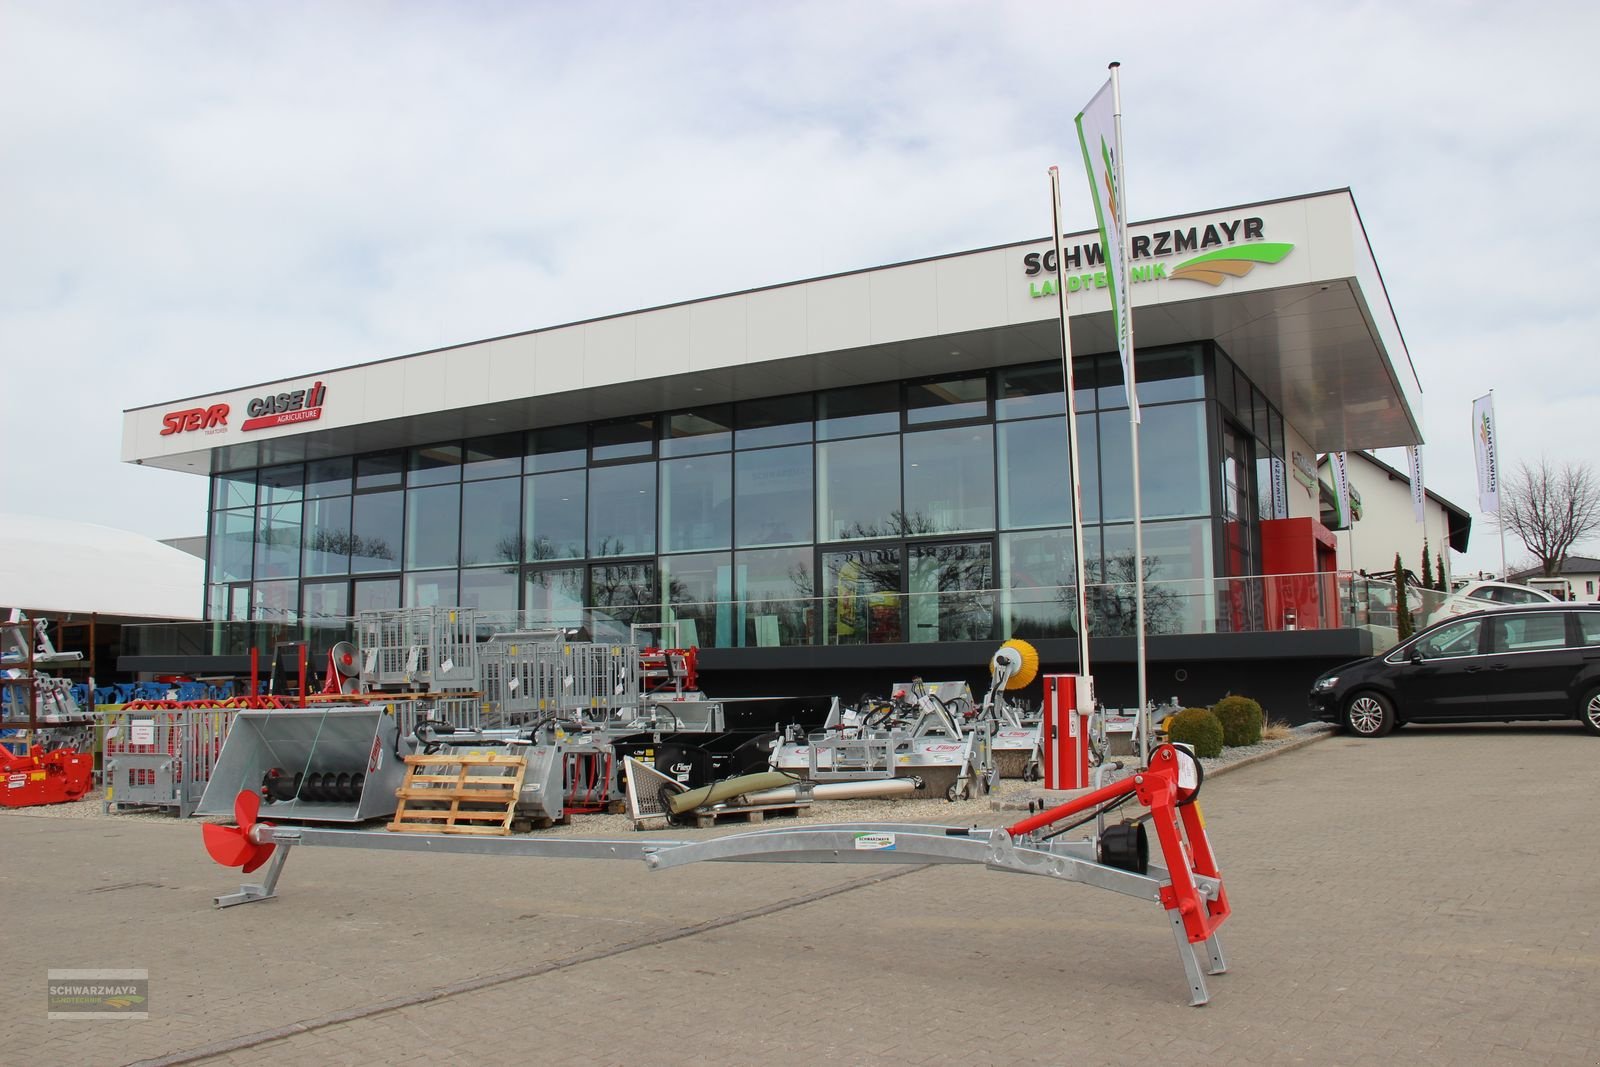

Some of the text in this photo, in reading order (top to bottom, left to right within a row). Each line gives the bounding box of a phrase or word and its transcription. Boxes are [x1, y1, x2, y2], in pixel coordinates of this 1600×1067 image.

[1023, 216, 1264, 276] SCHWRZMAYR
[1029, 262, 1168, 298] LADTENIK
[159, 403, 230, 436] STEYR
[246, 389, 305, 417] CASE
[276, 409, 318, 424] AGRICULTURE
